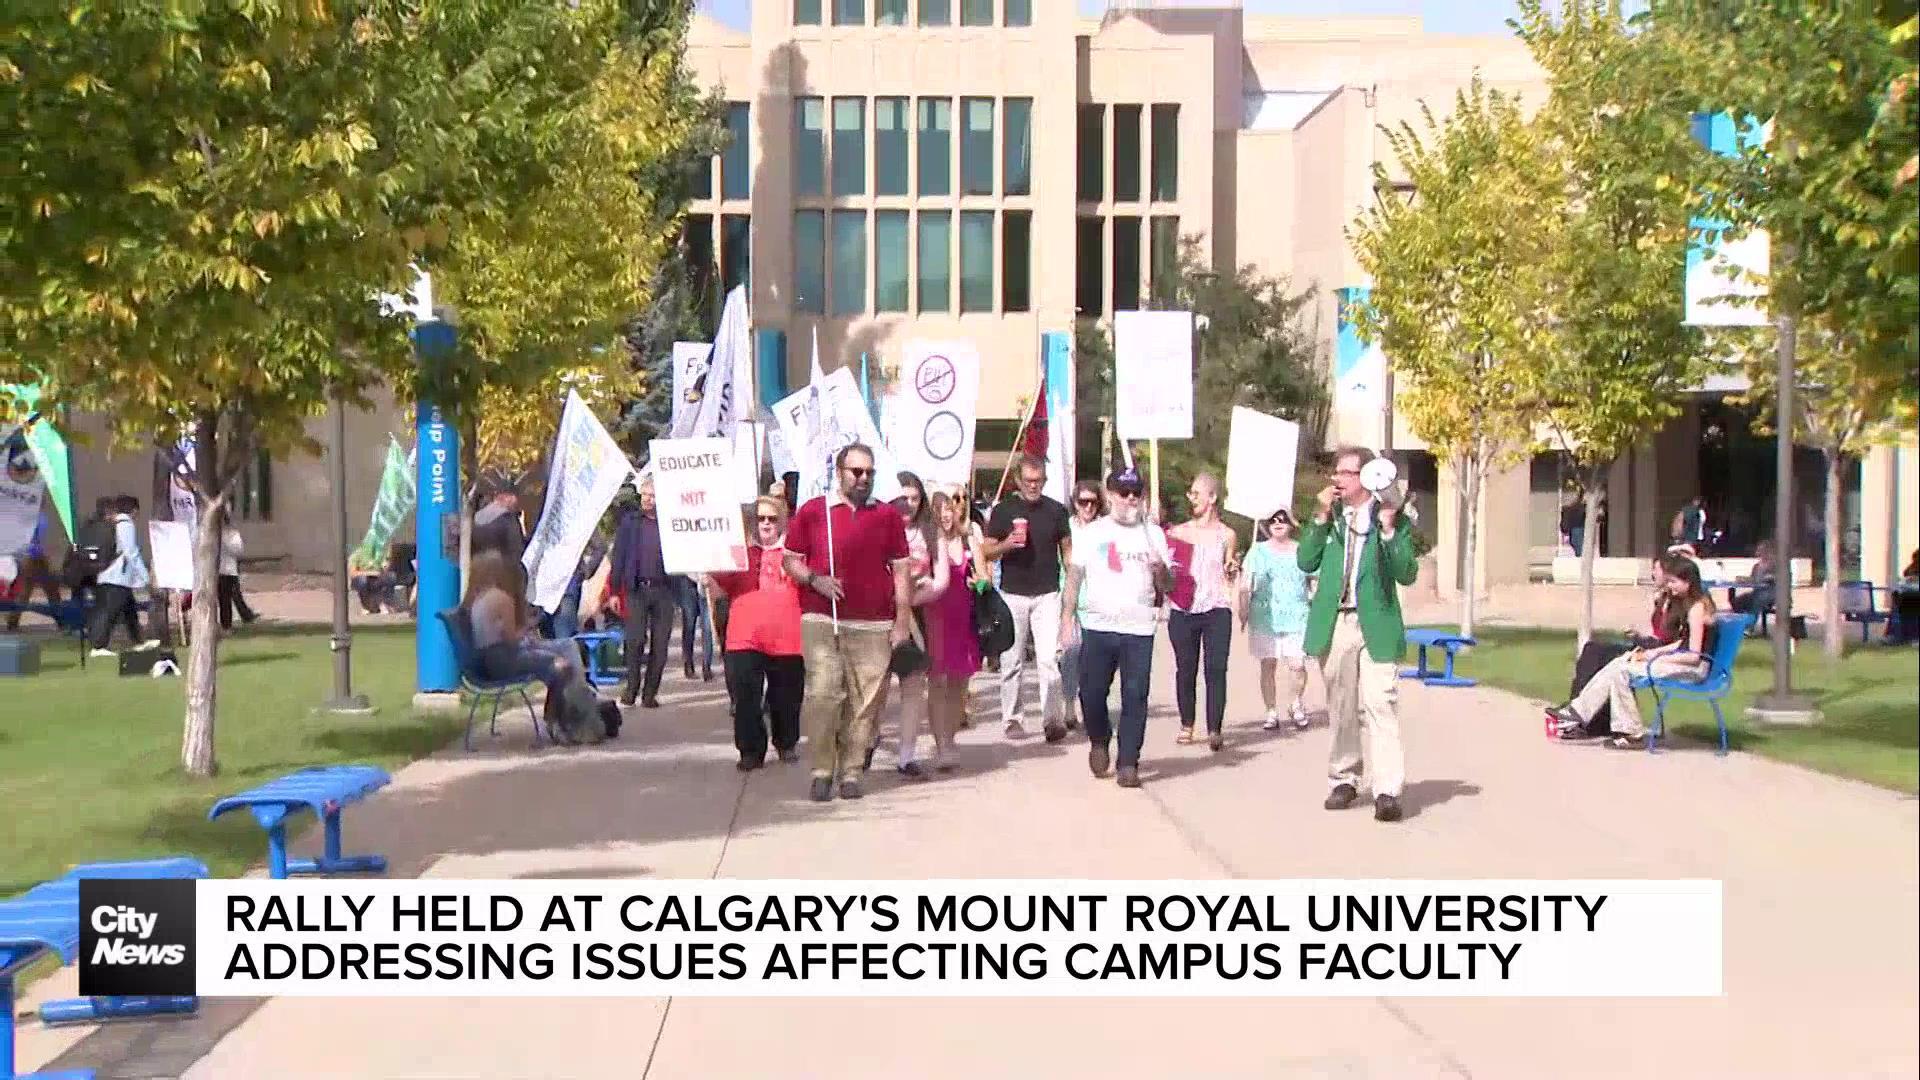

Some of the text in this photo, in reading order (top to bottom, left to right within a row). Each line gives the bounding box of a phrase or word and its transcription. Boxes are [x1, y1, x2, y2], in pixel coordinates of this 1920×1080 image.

[659, 453, 722, 471] EDUCATE
[432, 449, 449, 505] Point
[681, 490, 706, 507] NOT
